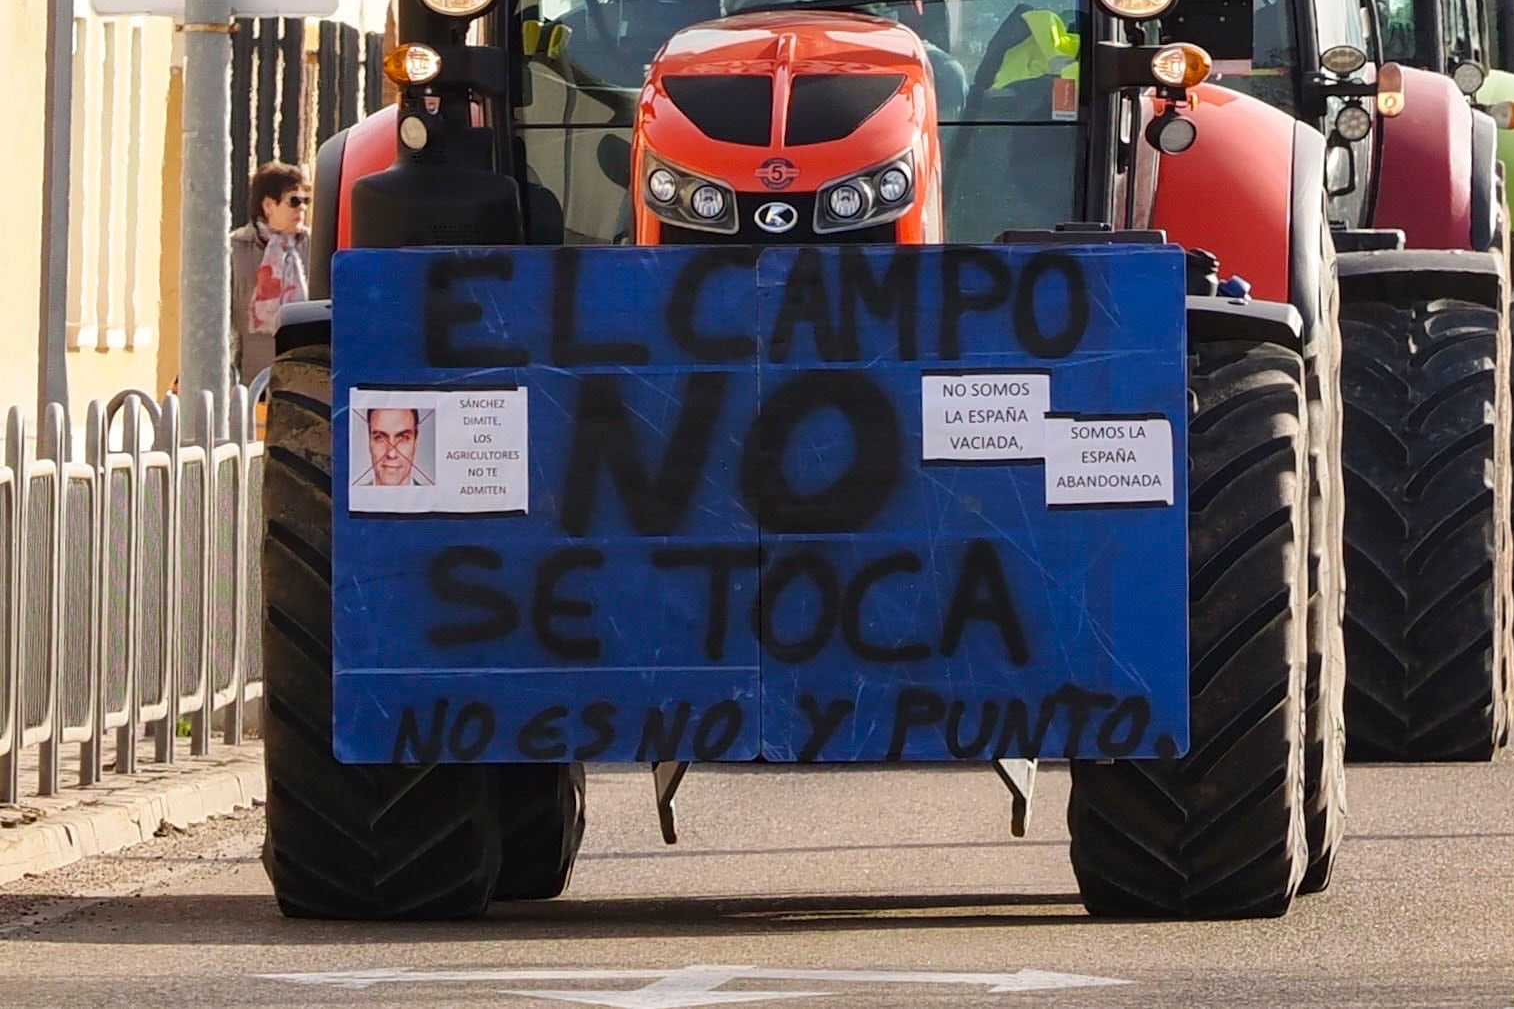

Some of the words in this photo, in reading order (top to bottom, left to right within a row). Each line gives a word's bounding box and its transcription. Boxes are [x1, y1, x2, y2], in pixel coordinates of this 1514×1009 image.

[770, 165, 783, 181] 5
[426, 247, 652, 368] EL
[666, 245, 1090, 362] CAMPO
[942, 383, 967, 397] NO
[971, 382, 1030, 397] SOMOS
[459, 397, 505, 409] SÁNCHEZ
[463, 416, 502, 427] DIMITE,
[945, 410, 964, 424] LA
[969, 406, 1028, 423] ESPAÑA
[473, 434, 492, 444] LOS
[1071, 426, 1125, 440] SOMOS
[1129, 426, 1146, 439] LA
[950, 436, 1024, 452] VACIADA,
[446, 450, 519, 461] AGRICULTORES
[560, 370, 902, 537] NO
[1081, 448, 1137, 464] ESPAÑA
[468, 467, 484, 478] NO
[487, 467, 498, 478] TE
[1056, 474, 1162, 488] ABANDONADA
[459, 485, 506, 496] ADMITEN
[427, 543, 605, 660] SE
[650, 537, 1031, 667] TOCA
[392, 696, 496, 764] NO
[516, 700, 617, 762] ES
[635, 698, 744, 762] NO
[796, 695, 854, 762] Y
[887, 682, 1179, 763] PUNTO.
